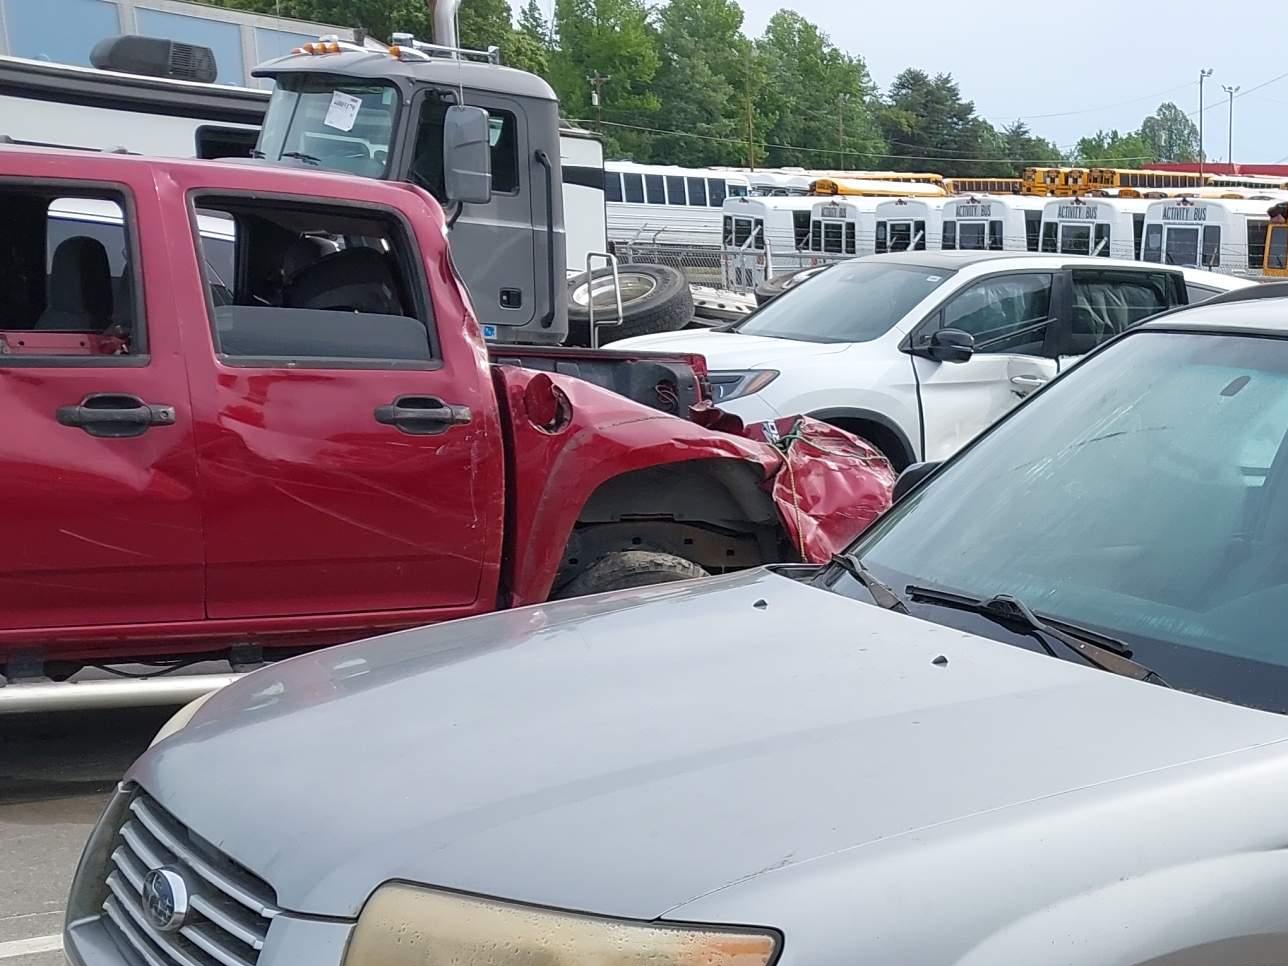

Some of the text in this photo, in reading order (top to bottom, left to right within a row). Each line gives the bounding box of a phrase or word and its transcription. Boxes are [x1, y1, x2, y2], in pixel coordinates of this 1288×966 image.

[839, 207, 847, 218] BUS
[956, 205, 991, 217] ACTIVITY BUS
[1057, 205, 1097, 219] ACTIVITY BUS
[1162, 207, 1206, 221] ACTIVITY BUS
